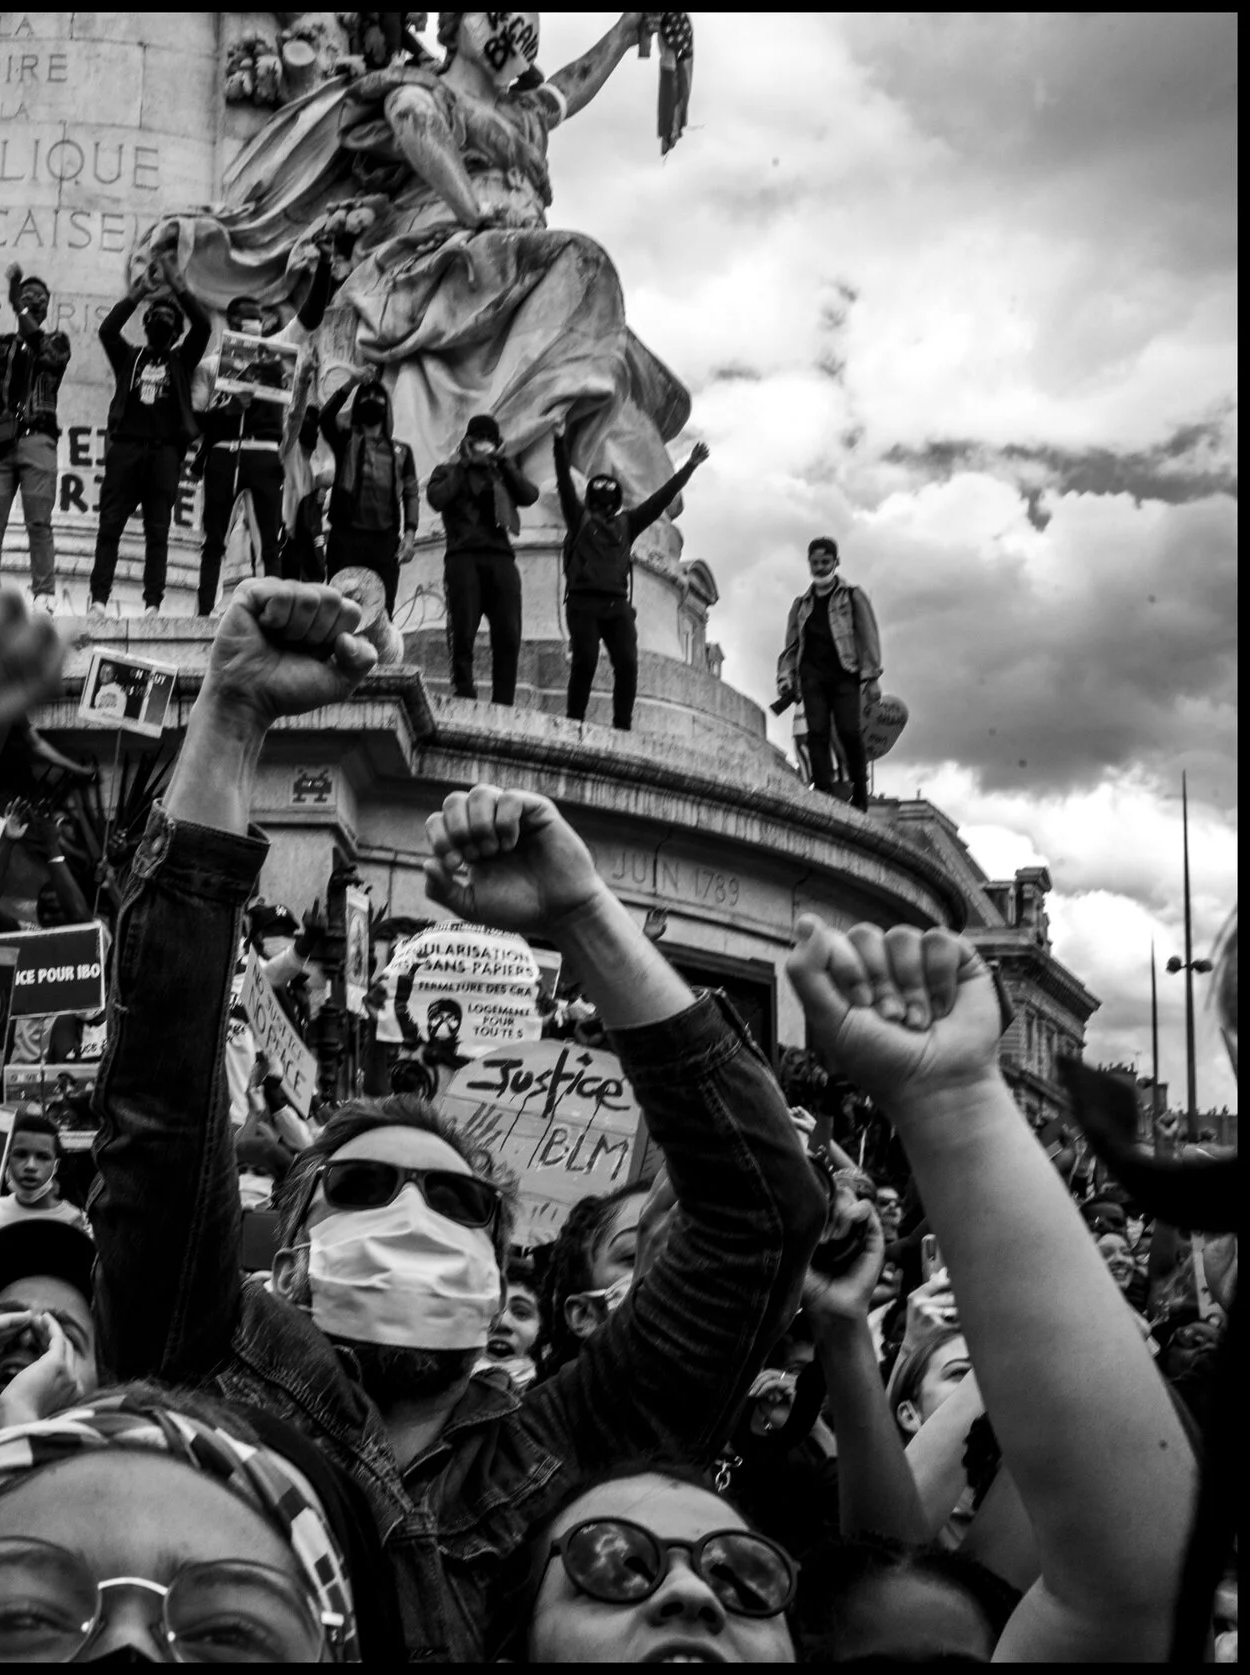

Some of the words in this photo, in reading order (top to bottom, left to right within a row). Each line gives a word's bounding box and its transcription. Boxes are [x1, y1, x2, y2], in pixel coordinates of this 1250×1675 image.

[0, 101, 31, 122] LA
[694, 866, 740, 907] 1789
[418, 943, 530, 963] ULARISATION
[37, 964, 75, 984] POUR
[76, 962, 101, 981] IBO
[417, 981, 483, 993] FERMETURE
[485, 984, 508, 995] DES
[482, 1015, 515, 1027] POUR
[466, 1047, 631, 1119] Justice
[538, 1127, 629, 1181] BLM
